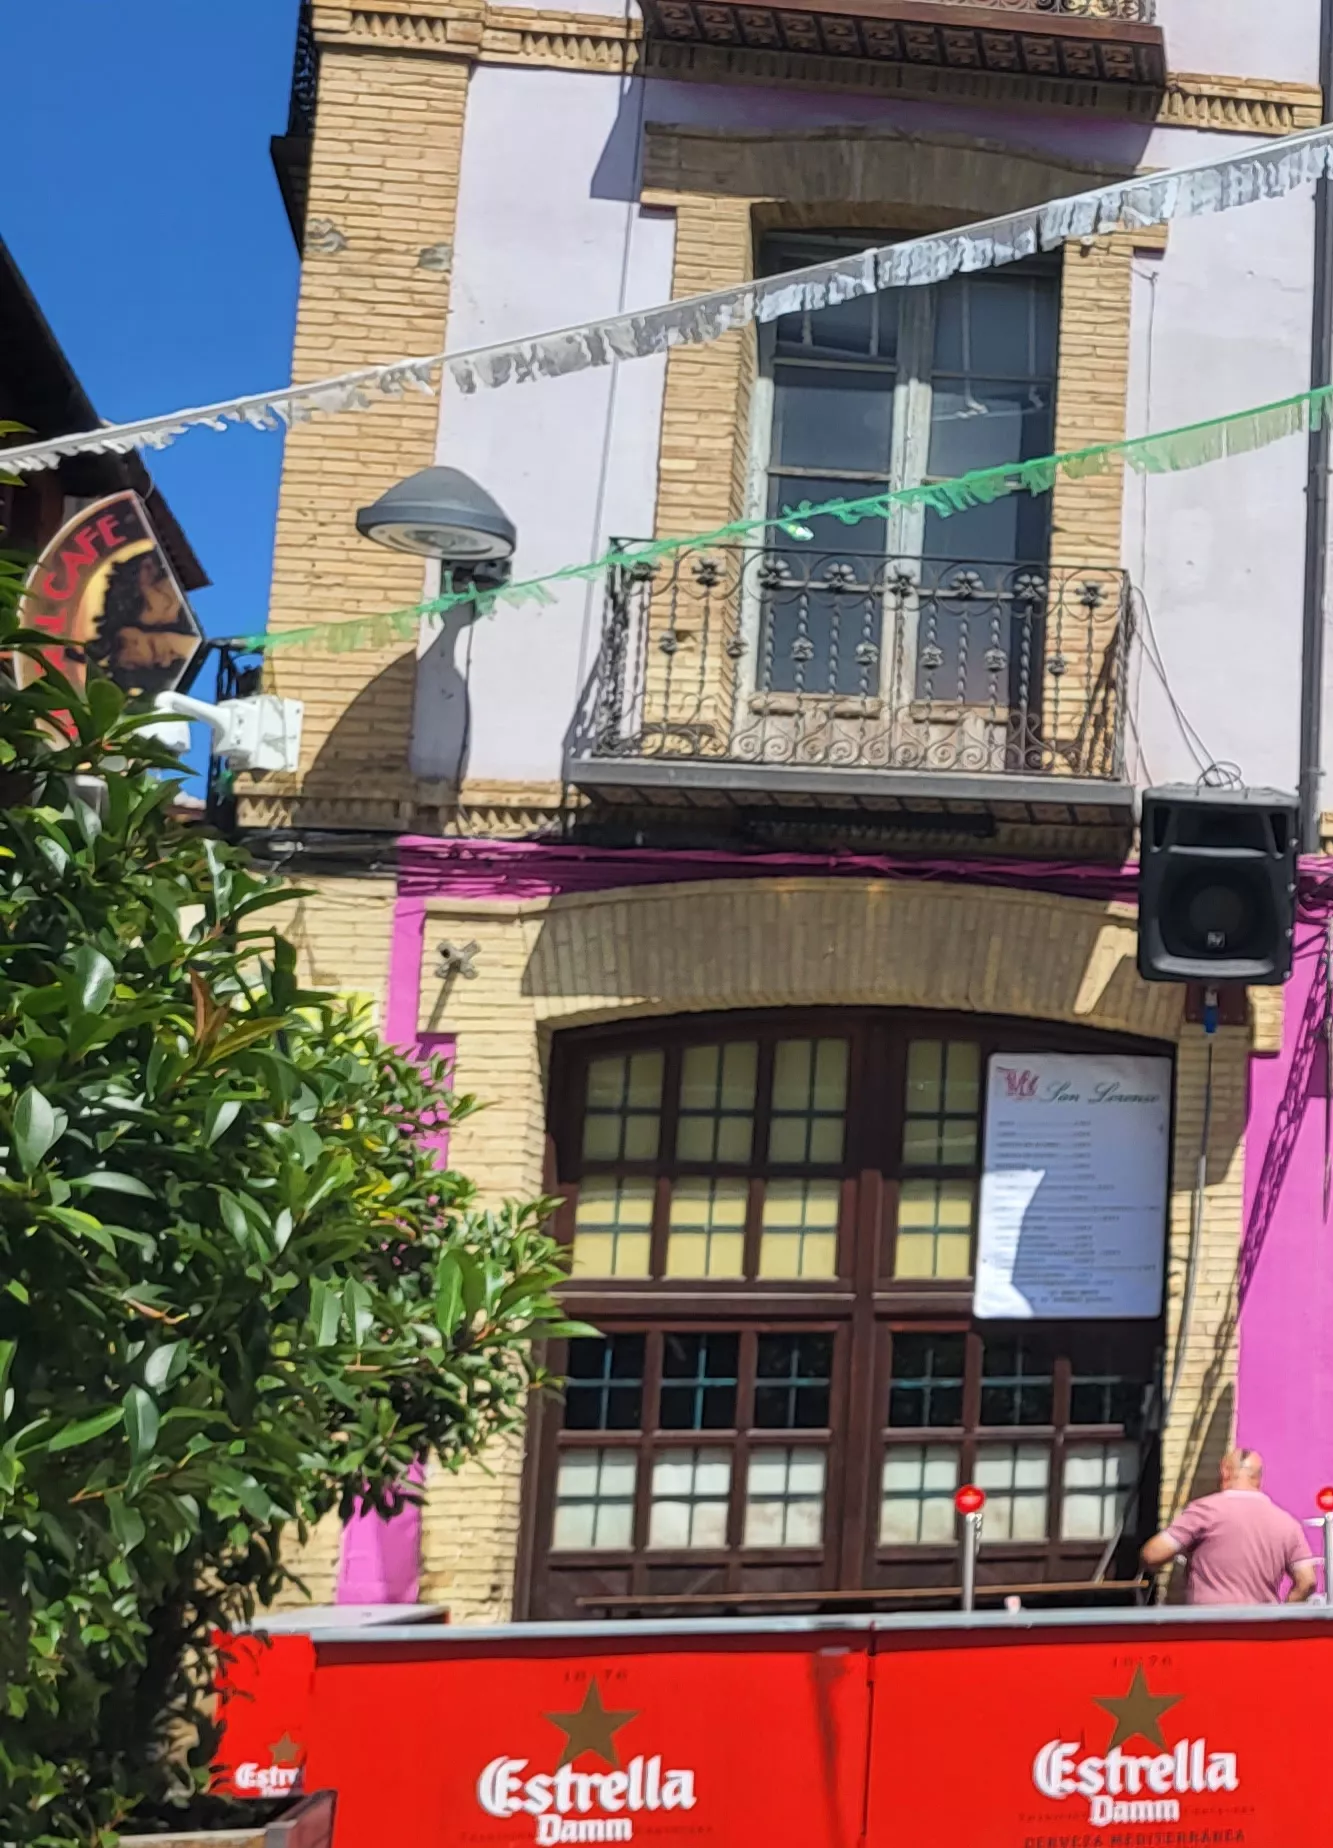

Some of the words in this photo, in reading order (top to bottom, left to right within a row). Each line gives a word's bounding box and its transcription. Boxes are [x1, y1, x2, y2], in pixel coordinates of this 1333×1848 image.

[476, 1754, 698, 1818] Estrella
[1033, 1737, 1241, 1800] Estrella
[535, 1812, 634, 1847] Damm
[1089, 1794, 1181, 1828] Damm
